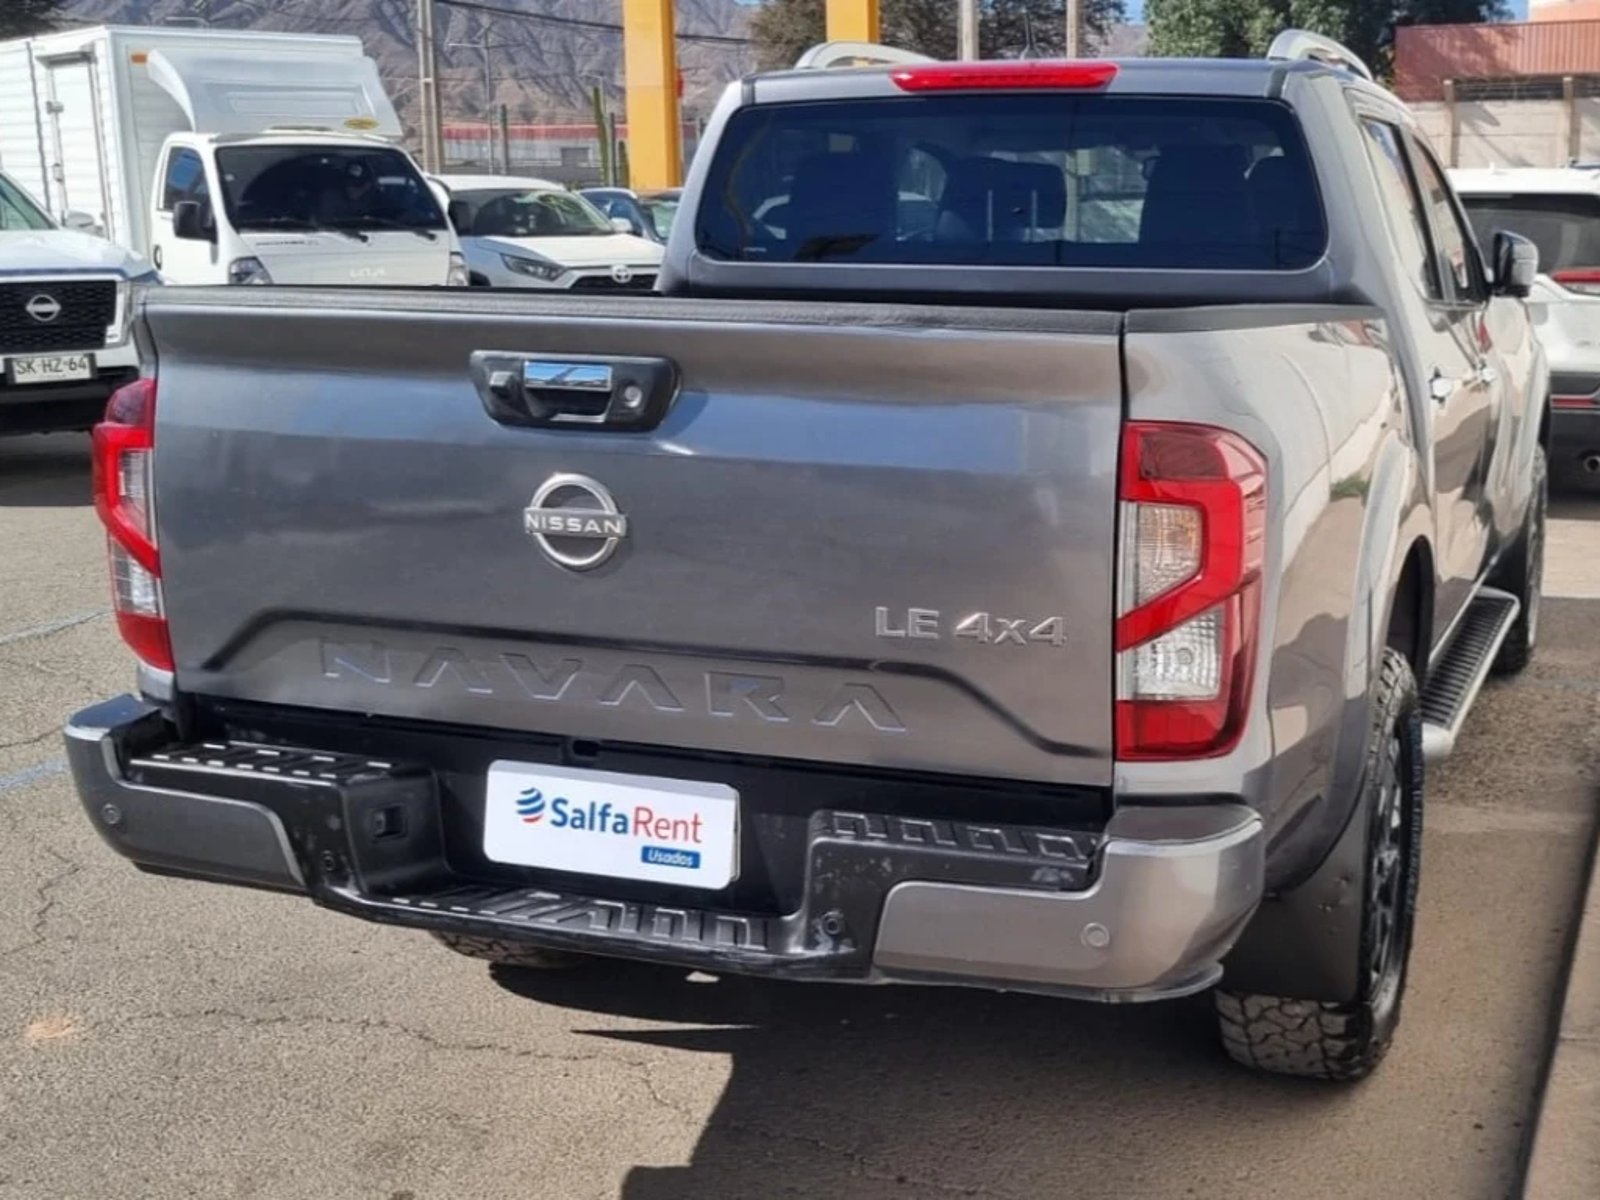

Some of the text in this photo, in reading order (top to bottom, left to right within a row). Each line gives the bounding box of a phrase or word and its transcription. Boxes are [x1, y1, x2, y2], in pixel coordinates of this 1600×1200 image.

[525, 513, 622, 534] NISSAN
[875, 606, 1067, 647] LE 4x4
[320, 638, 907, 733] NAVARA
[647, 848, 694, 867] Usados
